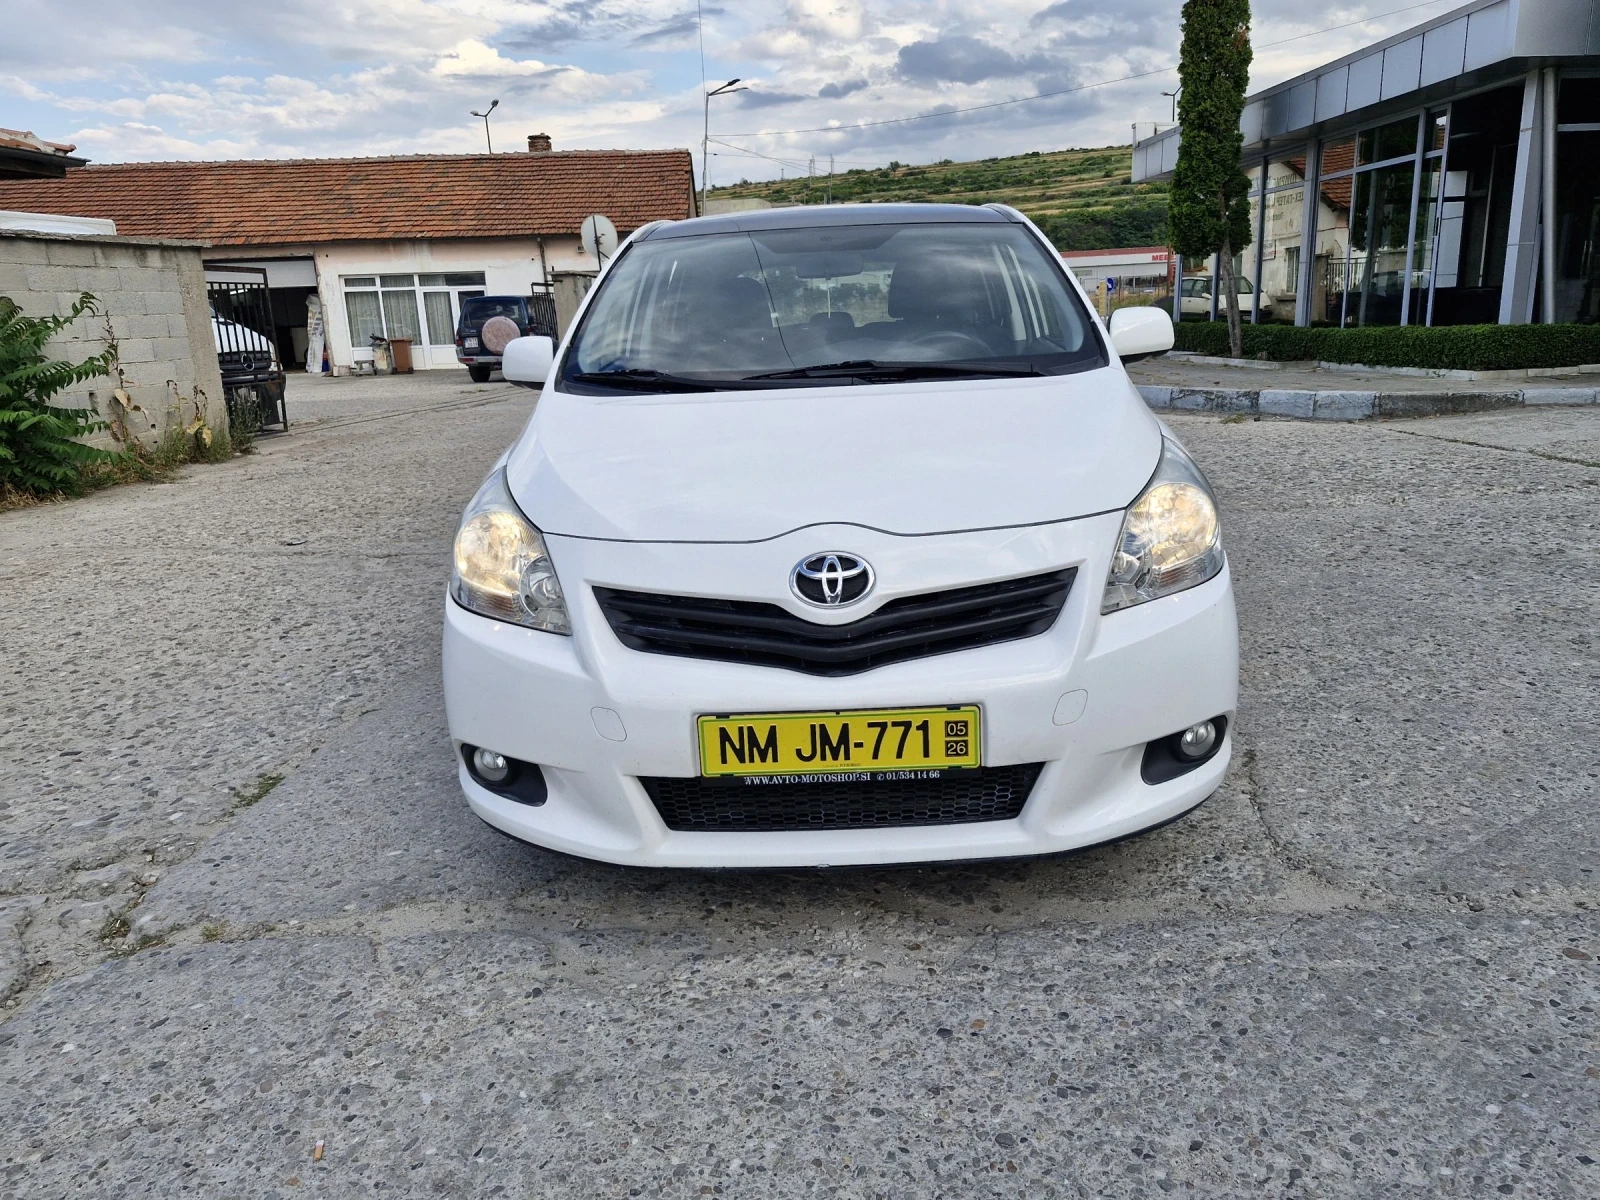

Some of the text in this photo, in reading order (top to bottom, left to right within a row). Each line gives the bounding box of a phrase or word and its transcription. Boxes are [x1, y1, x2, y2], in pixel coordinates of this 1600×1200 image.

[947, 722, 966, 735] 05
[718, 719, 931, 764] NM JM-771
[947, 740, 966, 754] 26
[743, 770, 941, 786] WWW.AVTO-MOTOSHOP.SI 01/534 14 66
